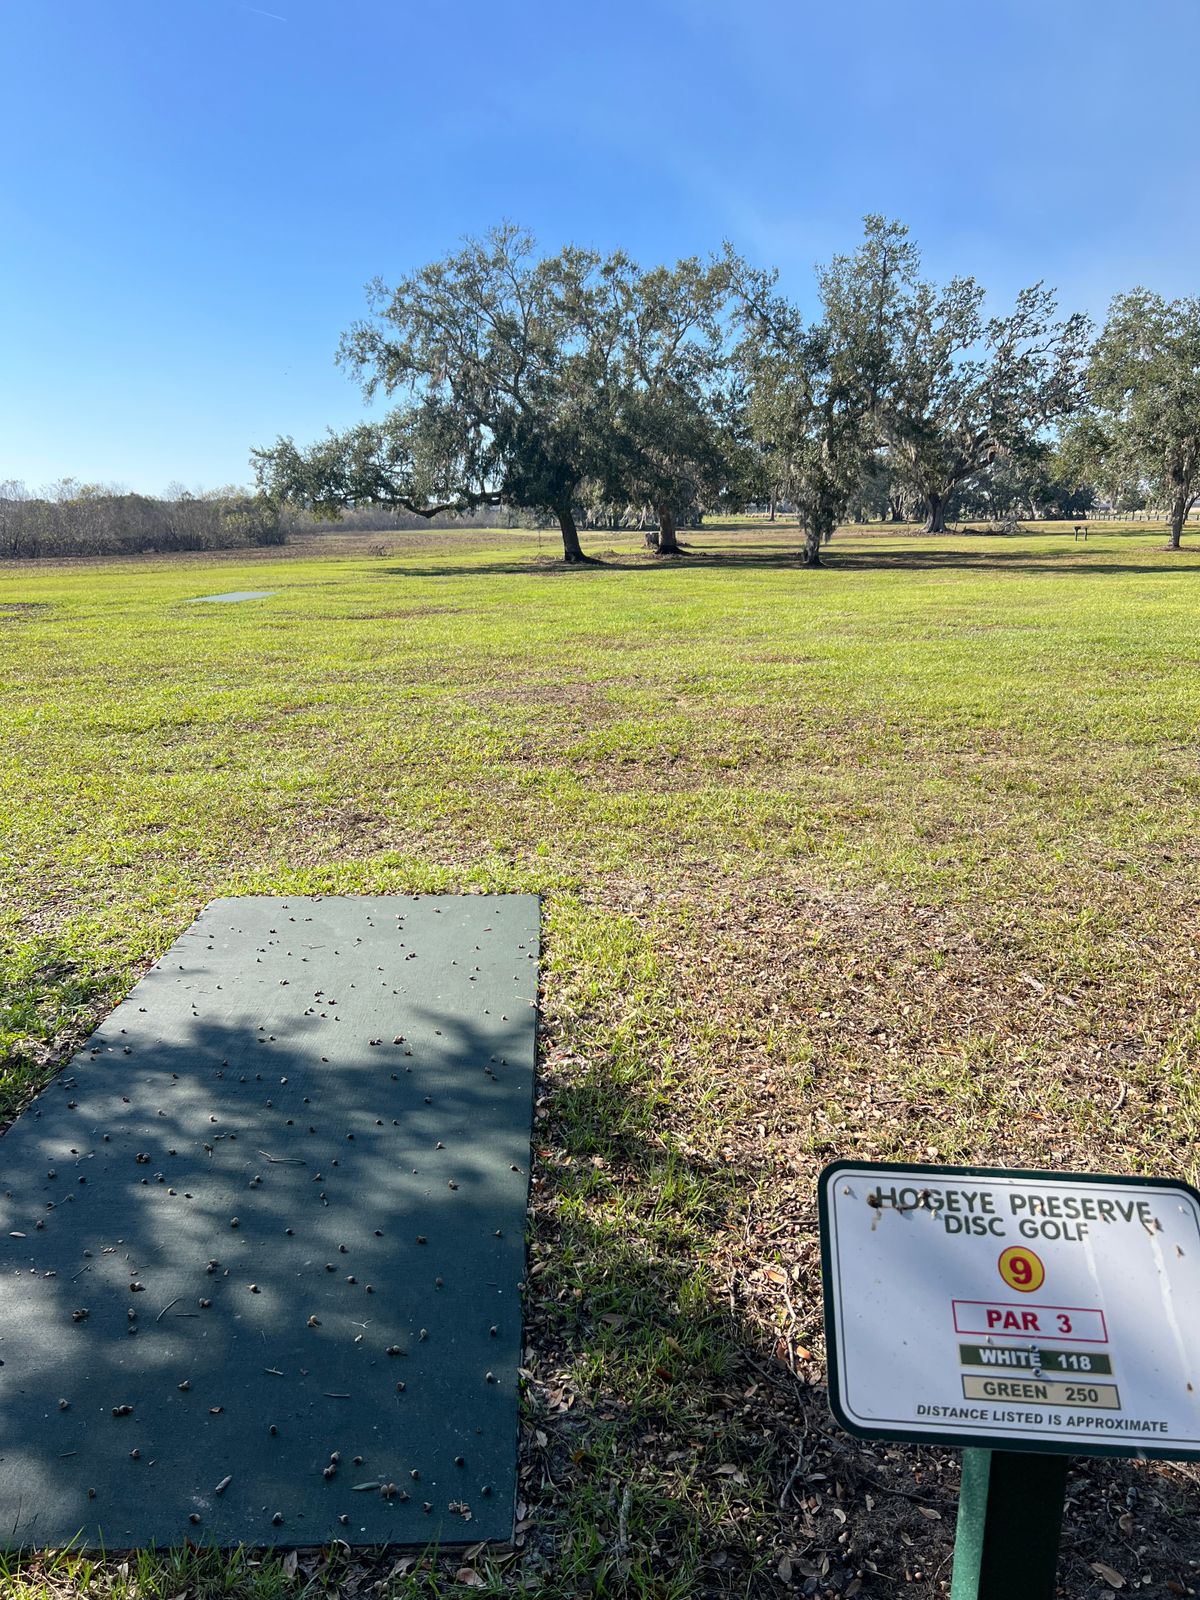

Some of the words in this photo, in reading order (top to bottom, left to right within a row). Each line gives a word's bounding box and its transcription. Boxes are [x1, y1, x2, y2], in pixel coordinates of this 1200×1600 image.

[875, 1186, 995, 1214] HOGEYE
[1009, 1193, 1152, 1223] PRESERVE
[944, 1214, 1006, 1237] DISC
[1019, 1218, 1089, 1242] GOLF
[1008, 1256, 1032, 1285] 9
[986, 1309, 1040, 1332] PAR
[1056, 1314, 1072, 1333] 3
[979, 1348, 1042, 1367] WHITE
[1058, 1354, 1092, 1370] 118
[983, 1382, 1048, 1400] GREEN
[1065, 1387, 1098, 1403] 250
[917, 1405, 989, 1420] DISTANCE
[993, 1411, 1043, 1425] LISTED
[1049, 1414, 1062, 1426] IS
[1067, 1416, 1169, 1433] APPROXIMATE
